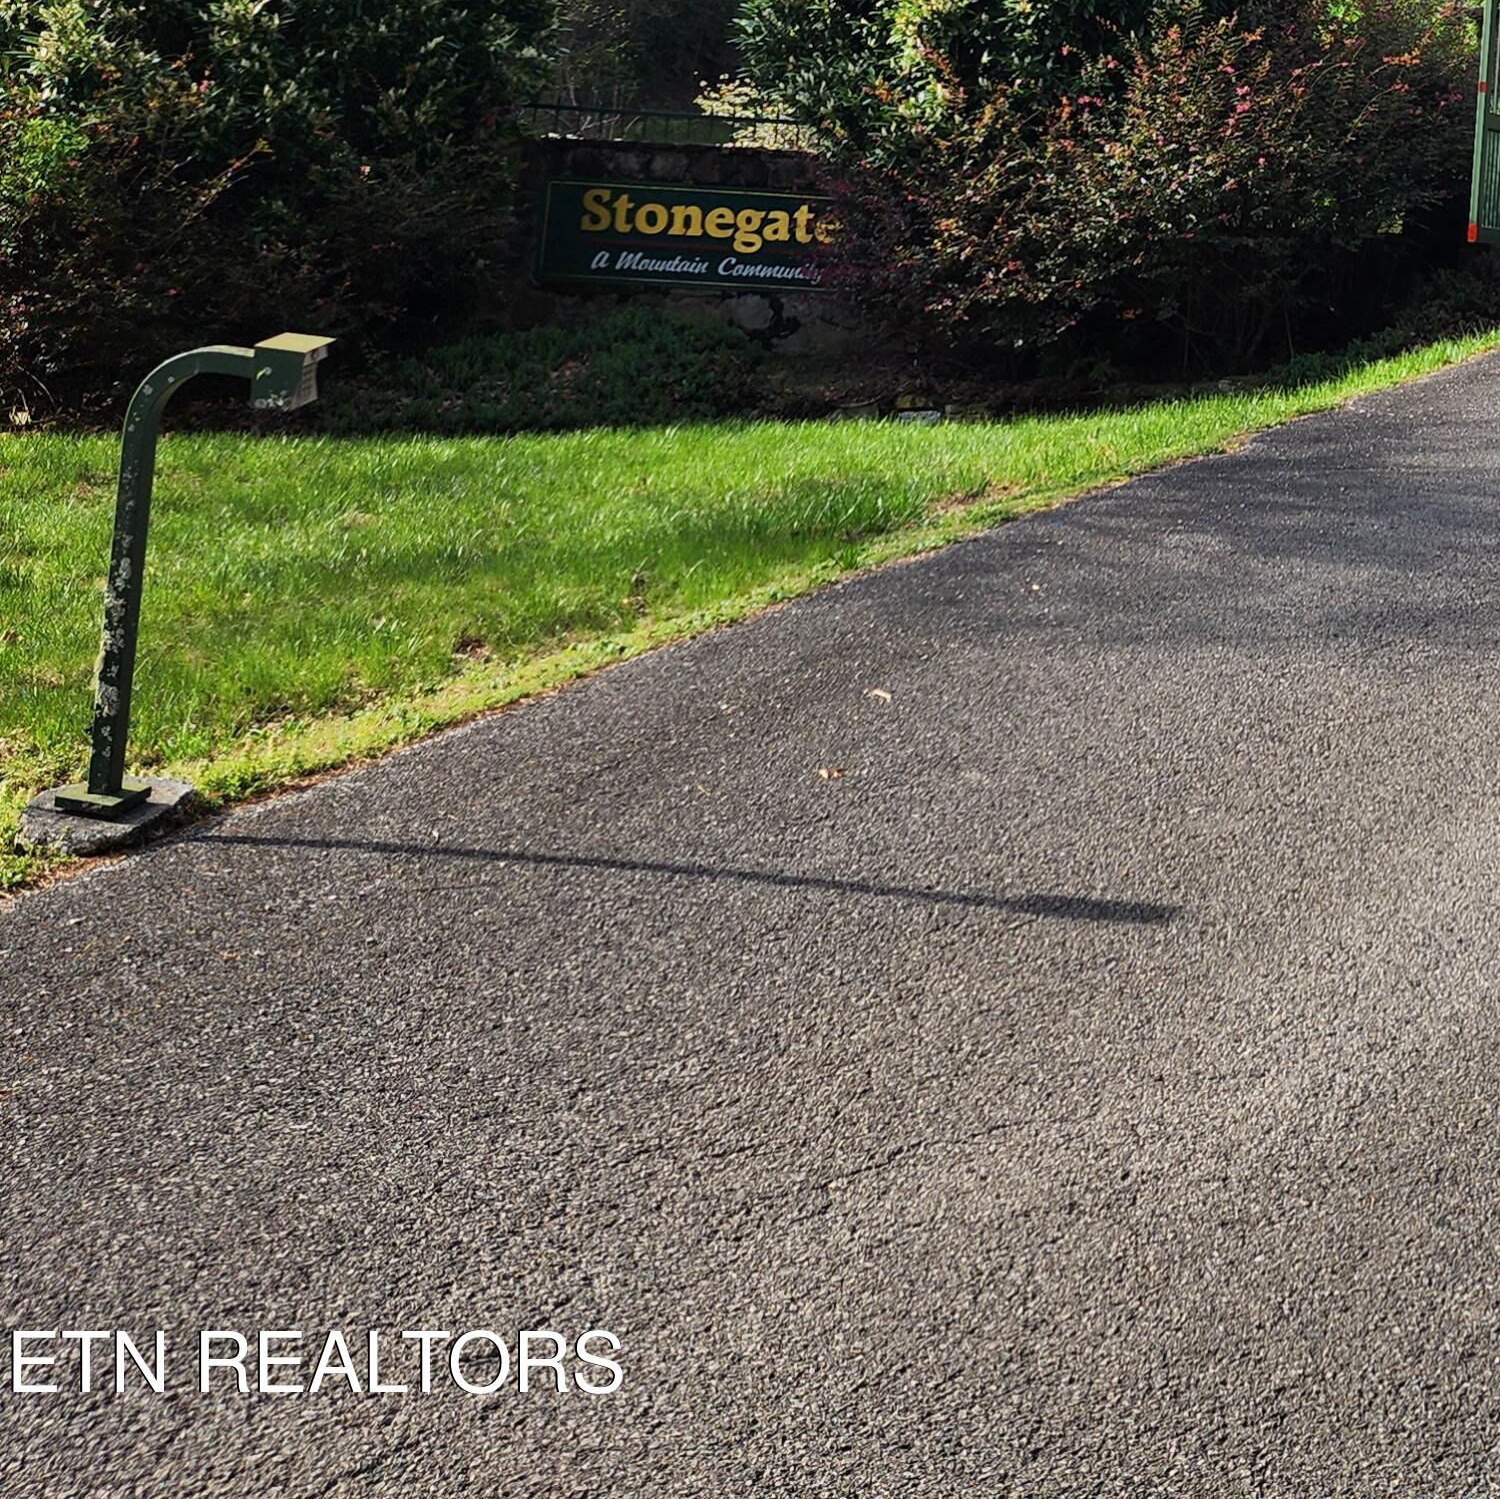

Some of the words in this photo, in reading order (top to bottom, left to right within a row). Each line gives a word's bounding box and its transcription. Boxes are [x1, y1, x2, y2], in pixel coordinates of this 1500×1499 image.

[580, 188, 844, 253] Stonegate
[590, 250, 611, 270] A
[615, 251, 709, 273] Mountain
